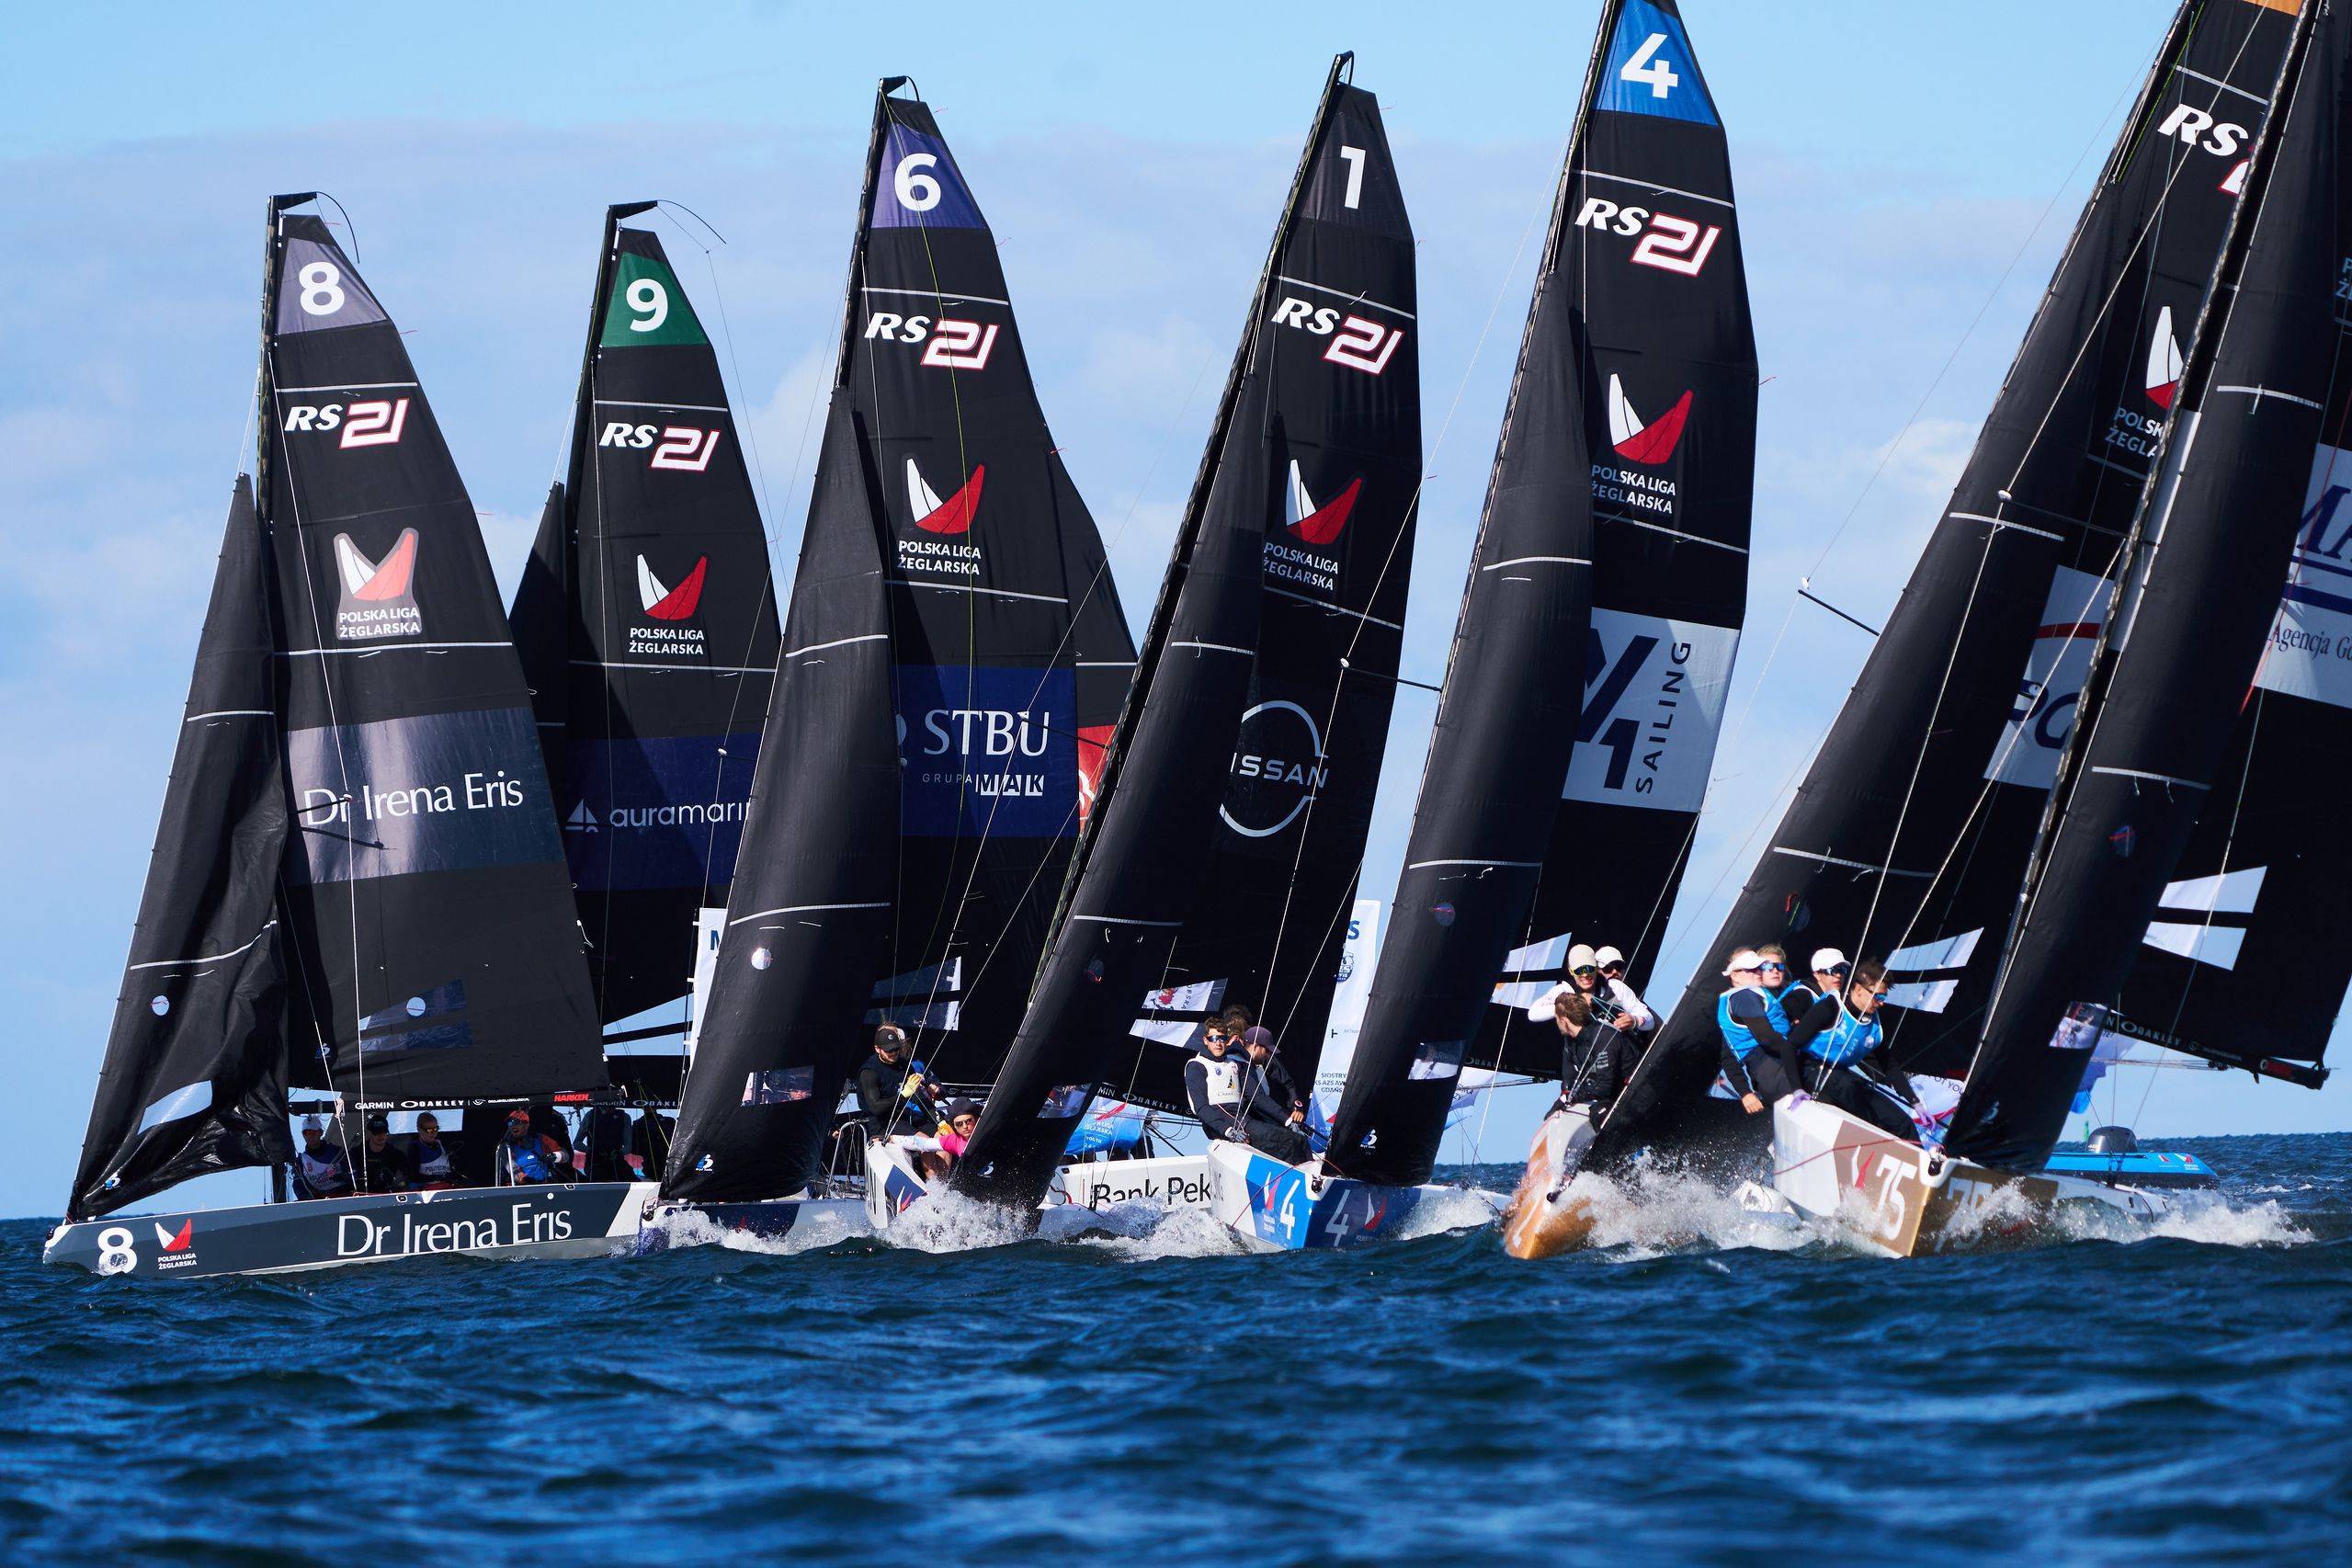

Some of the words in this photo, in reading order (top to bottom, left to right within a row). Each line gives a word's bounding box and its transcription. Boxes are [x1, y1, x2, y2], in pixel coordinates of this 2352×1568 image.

[1620, 33, 1678, 99] 4
[894, 153, 941, 211] 6
[1340, 145, 1366, 210] 1
[299, 262, 345, 314] 8
[626, 278, 668, 332] 9
[2114, 406, 2165, 438] POLSK
[1591, 464, 1645, 489] POLSKA
[1648, 477, 1676, 496] LIGA
[1591, 481, 1672, 514] ŻEGLARSKA
[897, 554, 980, 575] ŻEGLARSKA
[899, 540, 950, 555] POLSKA
[953, 545, 981, 559] LIGA
[1264, 542, 1312, 566] POLSKA
[1314, 556, 1338, 574] LIGA
[338, 608, 387, 624] POLSKA
[390, 607, 419, 620] LIGA
[339, 620, 420, 638] ŻEGLARSKA
[629, 639, 704, 654] ŻEGLARSKA
[630, 628, 676, 641] POLSKA
[678, 630, 704, 641] LIGA
[2267, 623, 2330, 660] Agencja
[1636, 642, 1691, 794] SAILING
[922, 773, 971, 783] GRUPA
[1230, 752, 1329, 789] ISSAN
[304, 788, 352, 826] Dr
[363, 783, 455, 822] Irena
[464, 770, 523, 811] Eris
[609, 802, 751, 827] auramari
[355, 1101, 394, 1109] GARMIN
[419, 1099, 463, 1108] OAKLEY
[554, 1093, 589, 1102] HARKEN
[1098, 1086, 1116, 1096] MIN
[1168, 1174, 1211, 1205] Pek
[1876, 1153, 1918, 1241] 75
[337, 1215, 390, 1256] Dr
[403, 1213, 500, 1254] Irena
[512, 1192, 572, 1244] Eris
[1280, 1179, 1301, 1240] 4
[1325, 1189, 1351, 1247] 4
[97, 1227, 138, 1276] 8
[158, 1254, 182, 1263] POLSKA
[158, 1259, 197, 1269] ŻEGLARSKA
